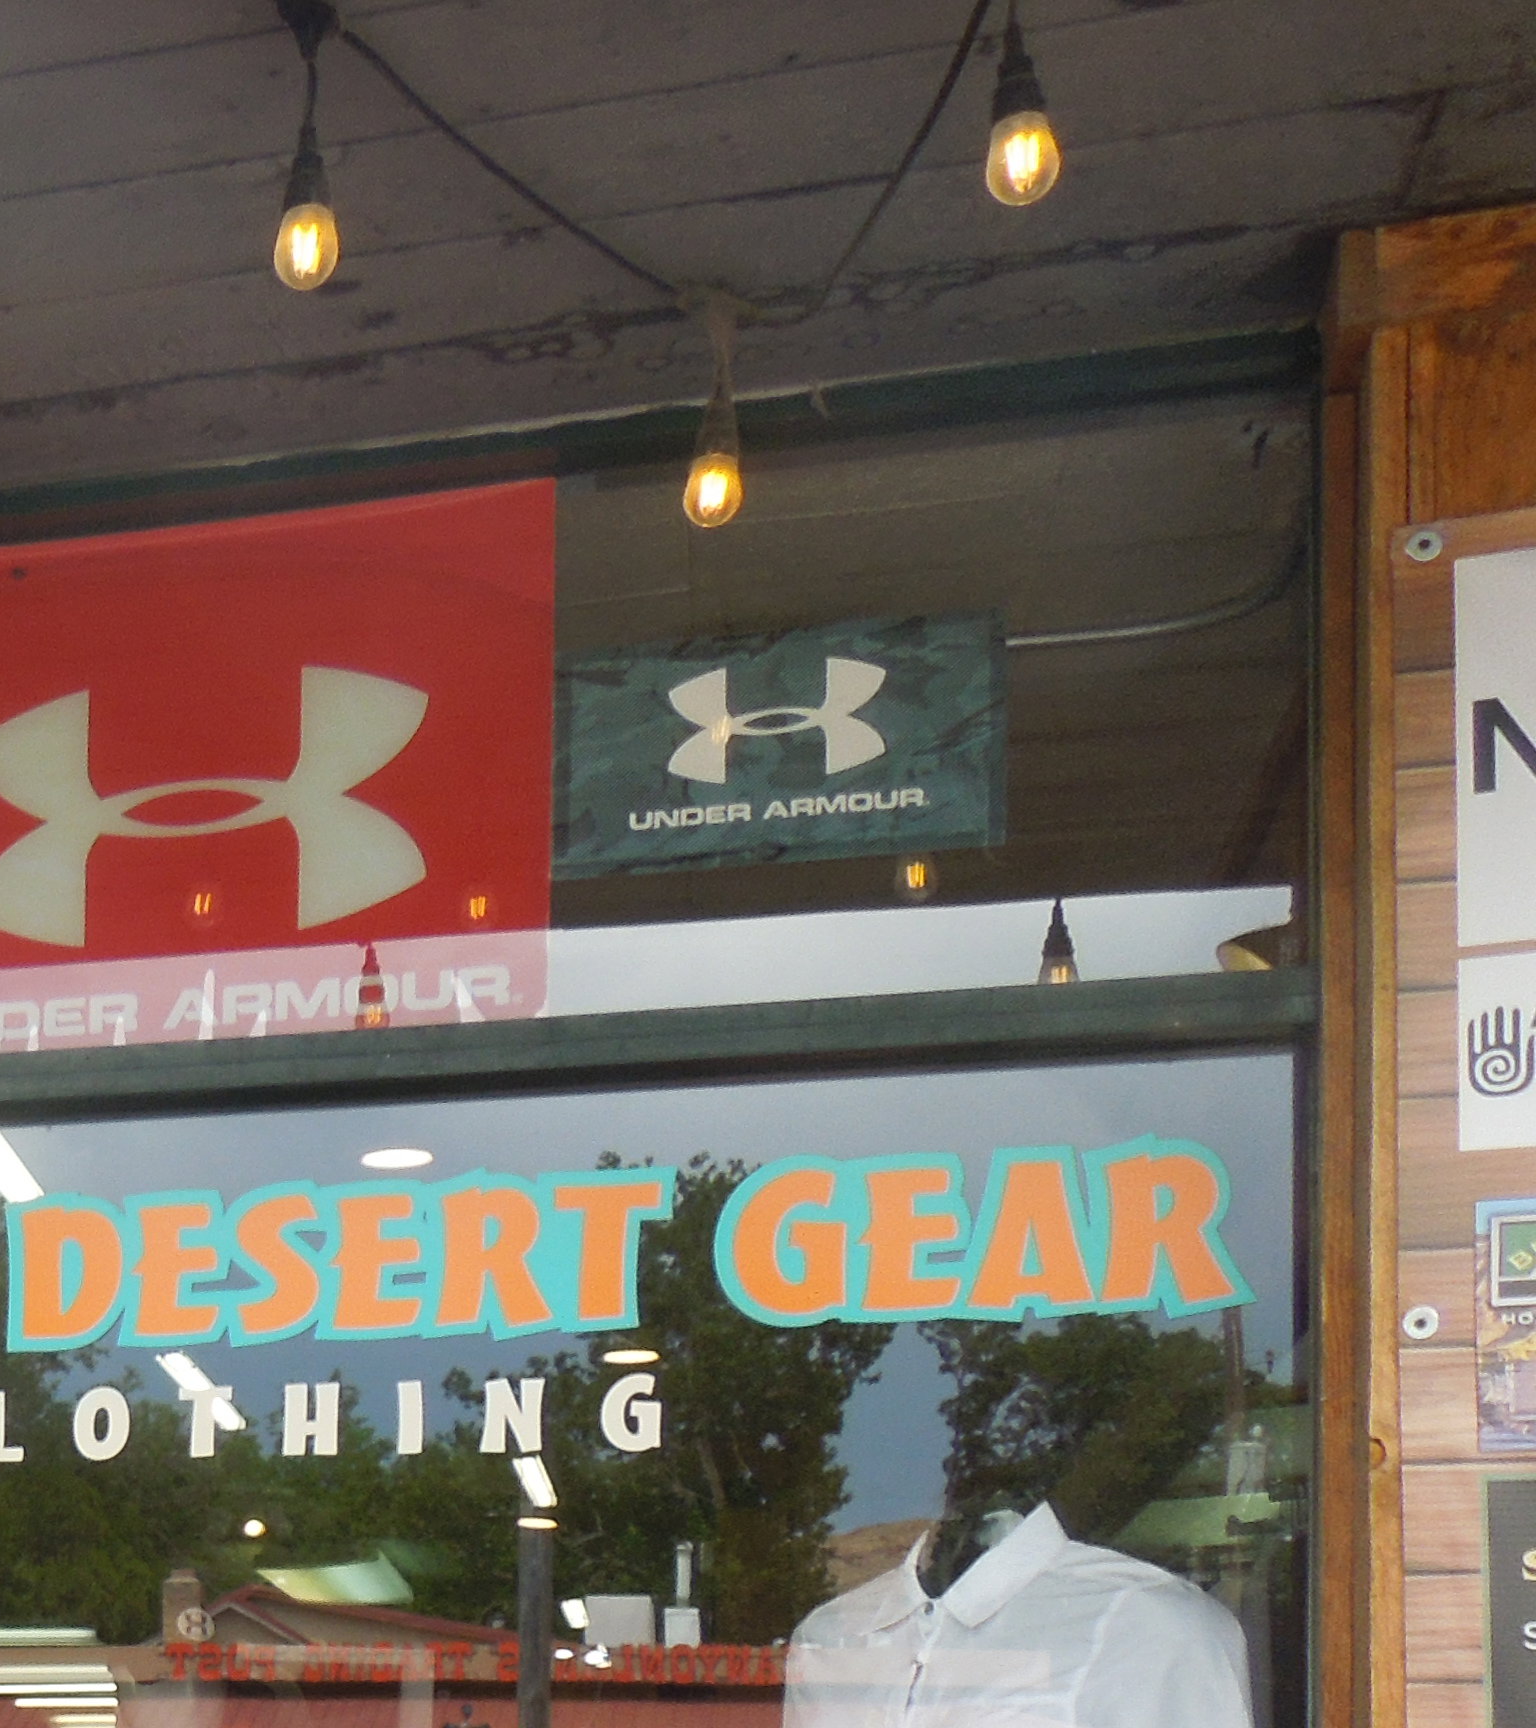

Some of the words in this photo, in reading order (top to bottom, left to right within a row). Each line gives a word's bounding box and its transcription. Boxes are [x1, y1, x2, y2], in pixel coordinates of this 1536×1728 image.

[629, 804, 753, 833] UNDER
[762, 788, 926, 818] ARMOUR
[162, 964, 510, 1032] ARMOUR
[6, 1164, 678, 1352] DESERT
[715, 1133, 1256, 1328] GEAR
